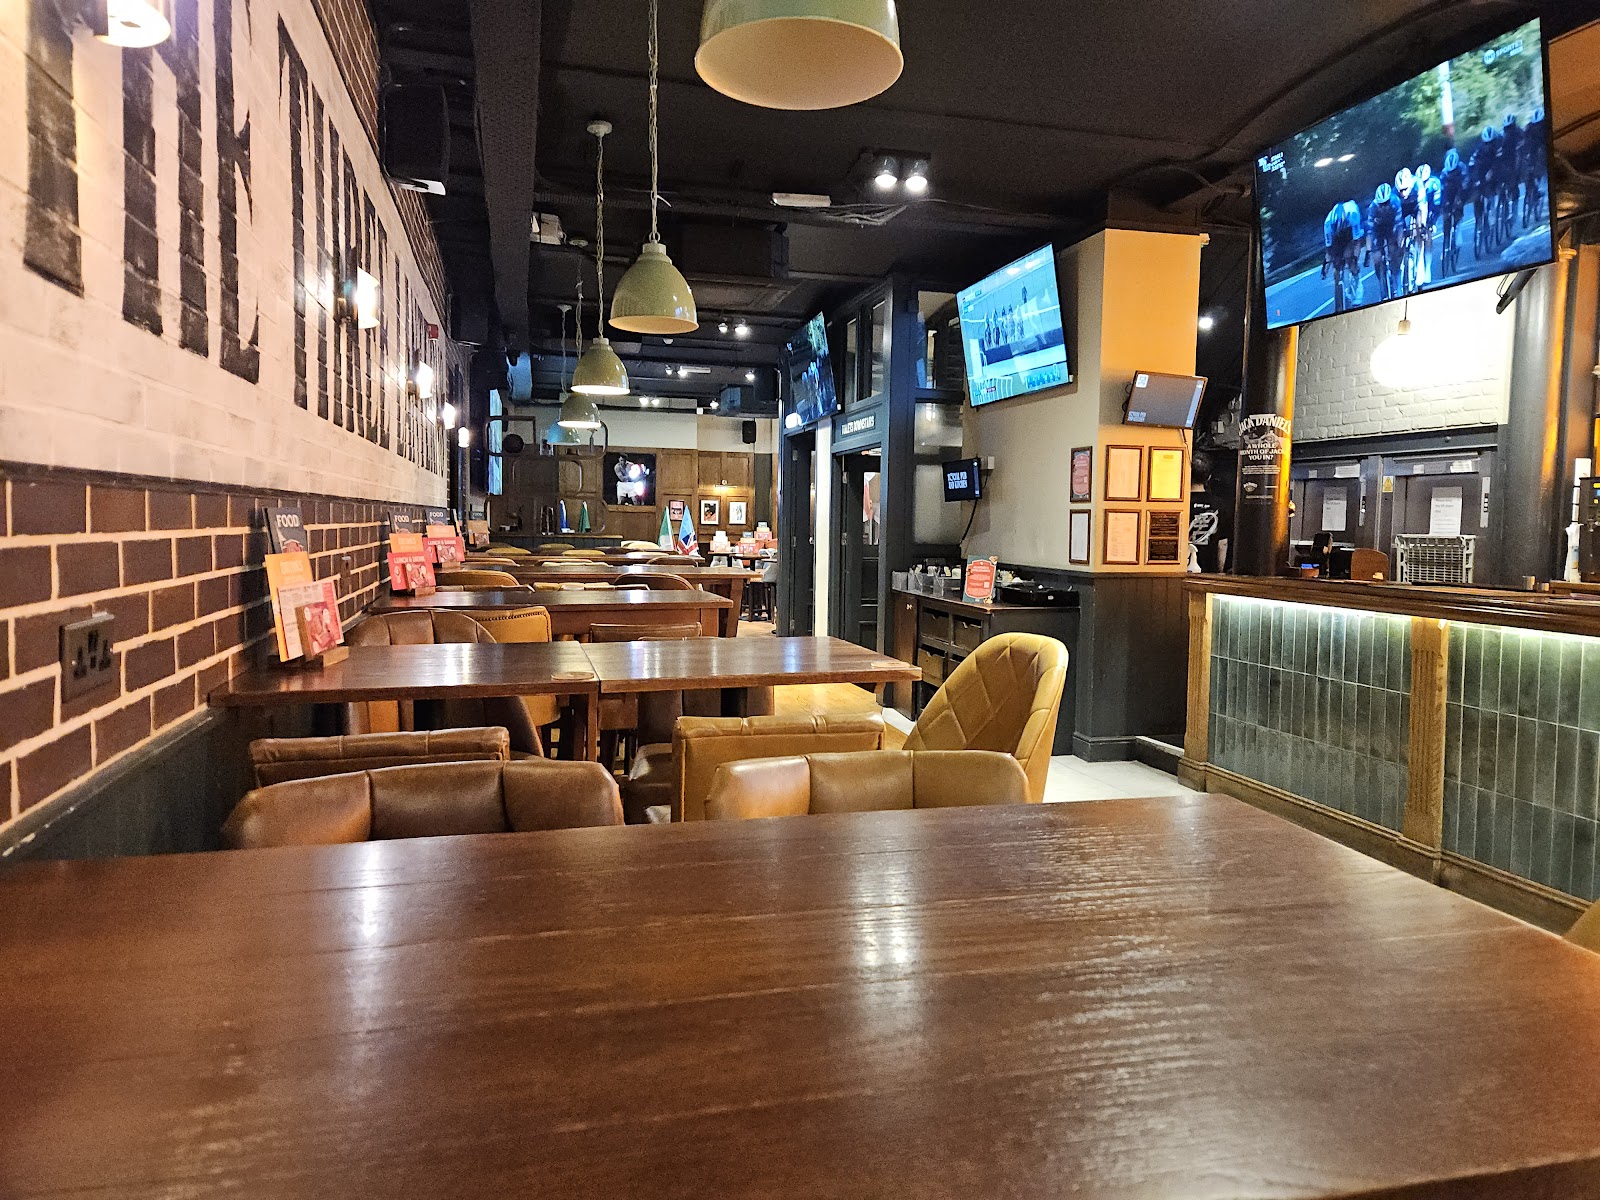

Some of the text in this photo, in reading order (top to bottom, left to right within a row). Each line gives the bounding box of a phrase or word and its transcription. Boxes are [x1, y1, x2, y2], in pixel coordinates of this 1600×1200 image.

[1239, 417, 1255, 436] JACK
[276, 514, 300, 528] FOOD
[394, 515, 410, 523] FOOD
